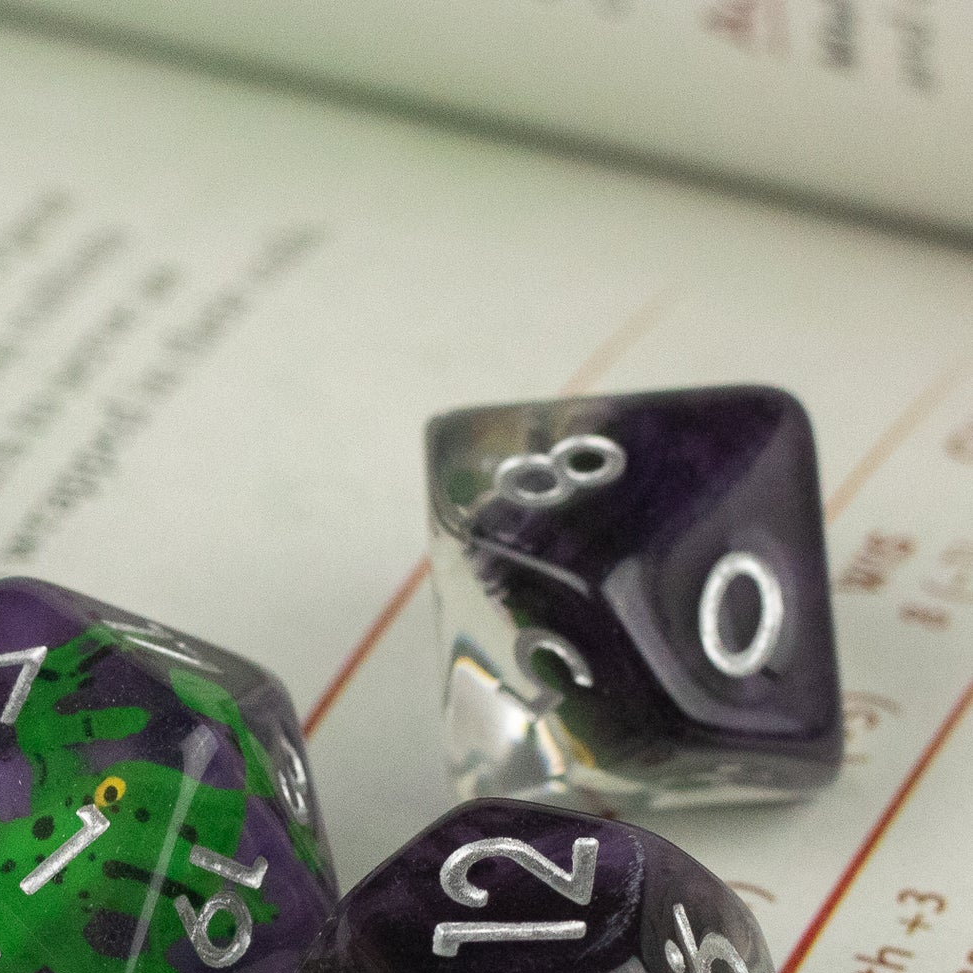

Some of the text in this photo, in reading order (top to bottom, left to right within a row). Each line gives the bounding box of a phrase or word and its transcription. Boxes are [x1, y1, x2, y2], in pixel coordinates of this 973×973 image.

[494, 434, 627, 506] 8
[698, 550, 785, 678] 0
[19, 803, 110, 895] 1
[432, 837, 600, 957] 12
[896, 887, 948, 936] +3
